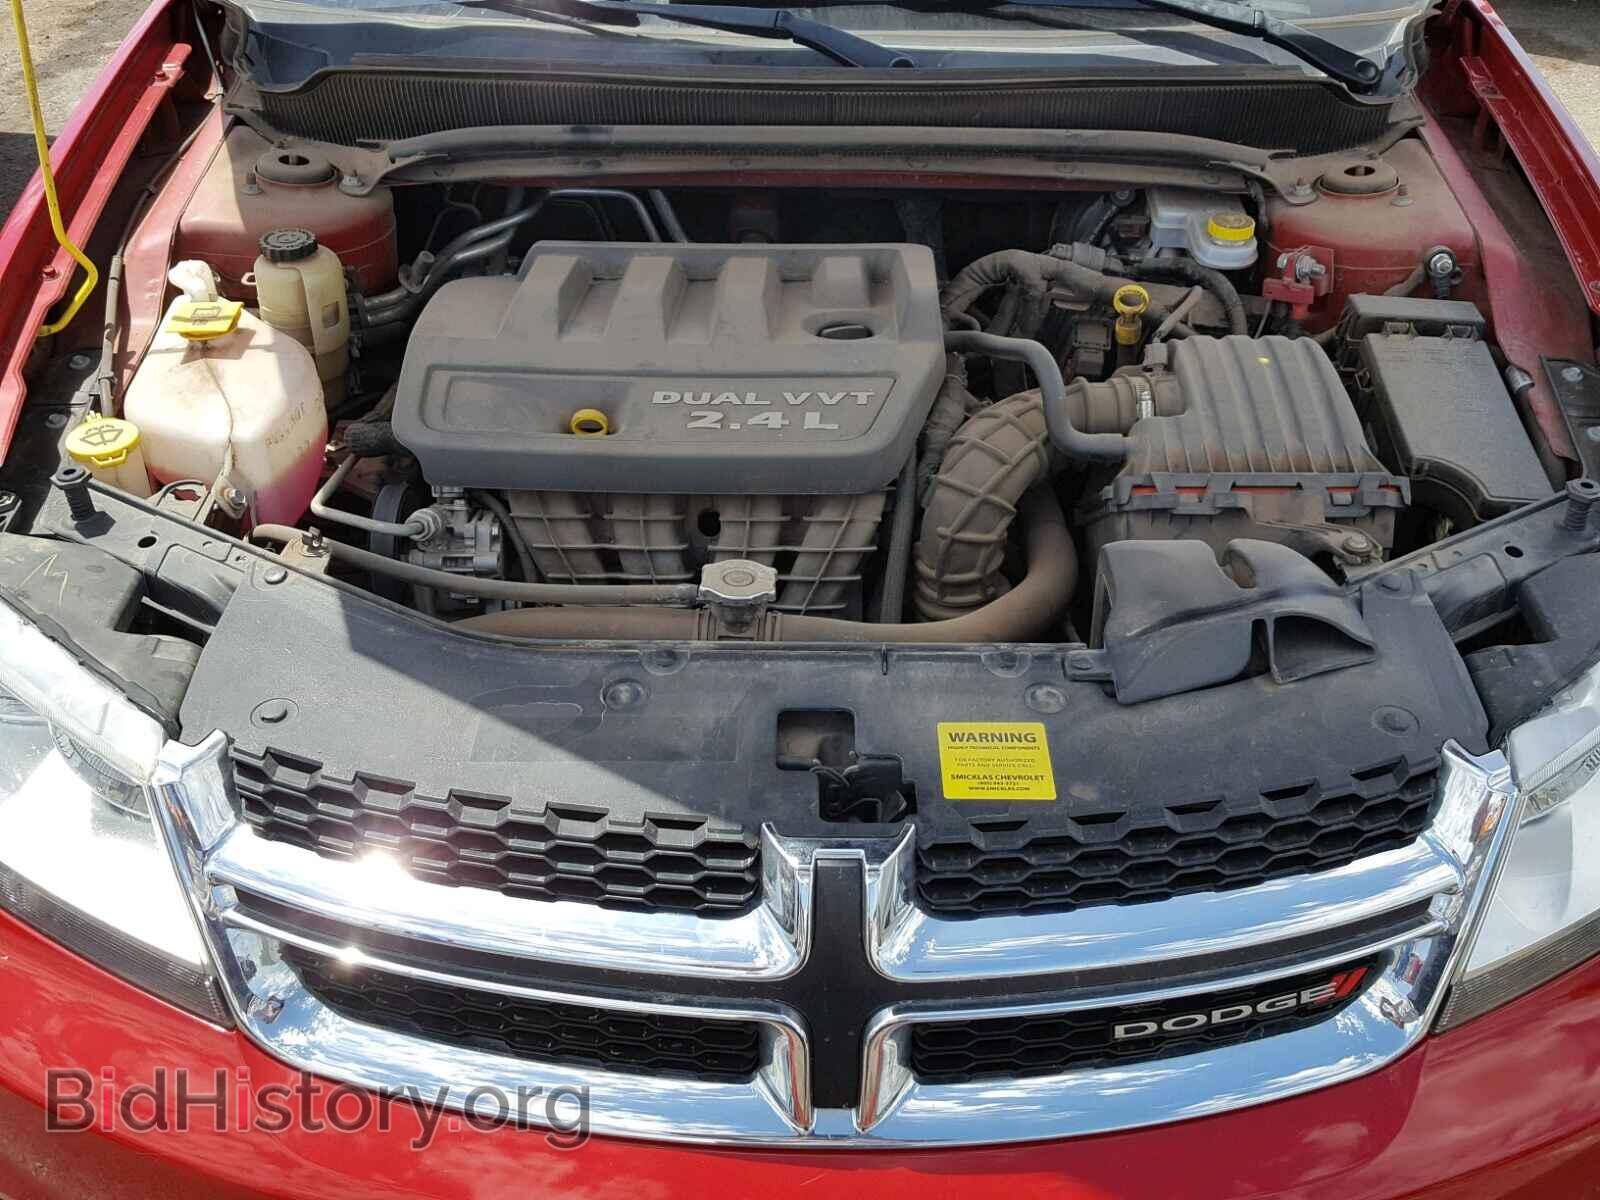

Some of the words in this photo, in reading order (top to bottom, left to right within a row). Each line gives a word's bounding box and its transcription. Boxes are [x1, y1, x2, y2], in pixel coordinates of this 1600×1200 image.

[652, 391, 771, 405] DUAL
[782, 391, 875, 405] VVT
[948, 732, 1037, 743] WARNING
[995, 774, 1045, 782] CHEVROLET
[1114, 981, 1337, 1039] DODGE
